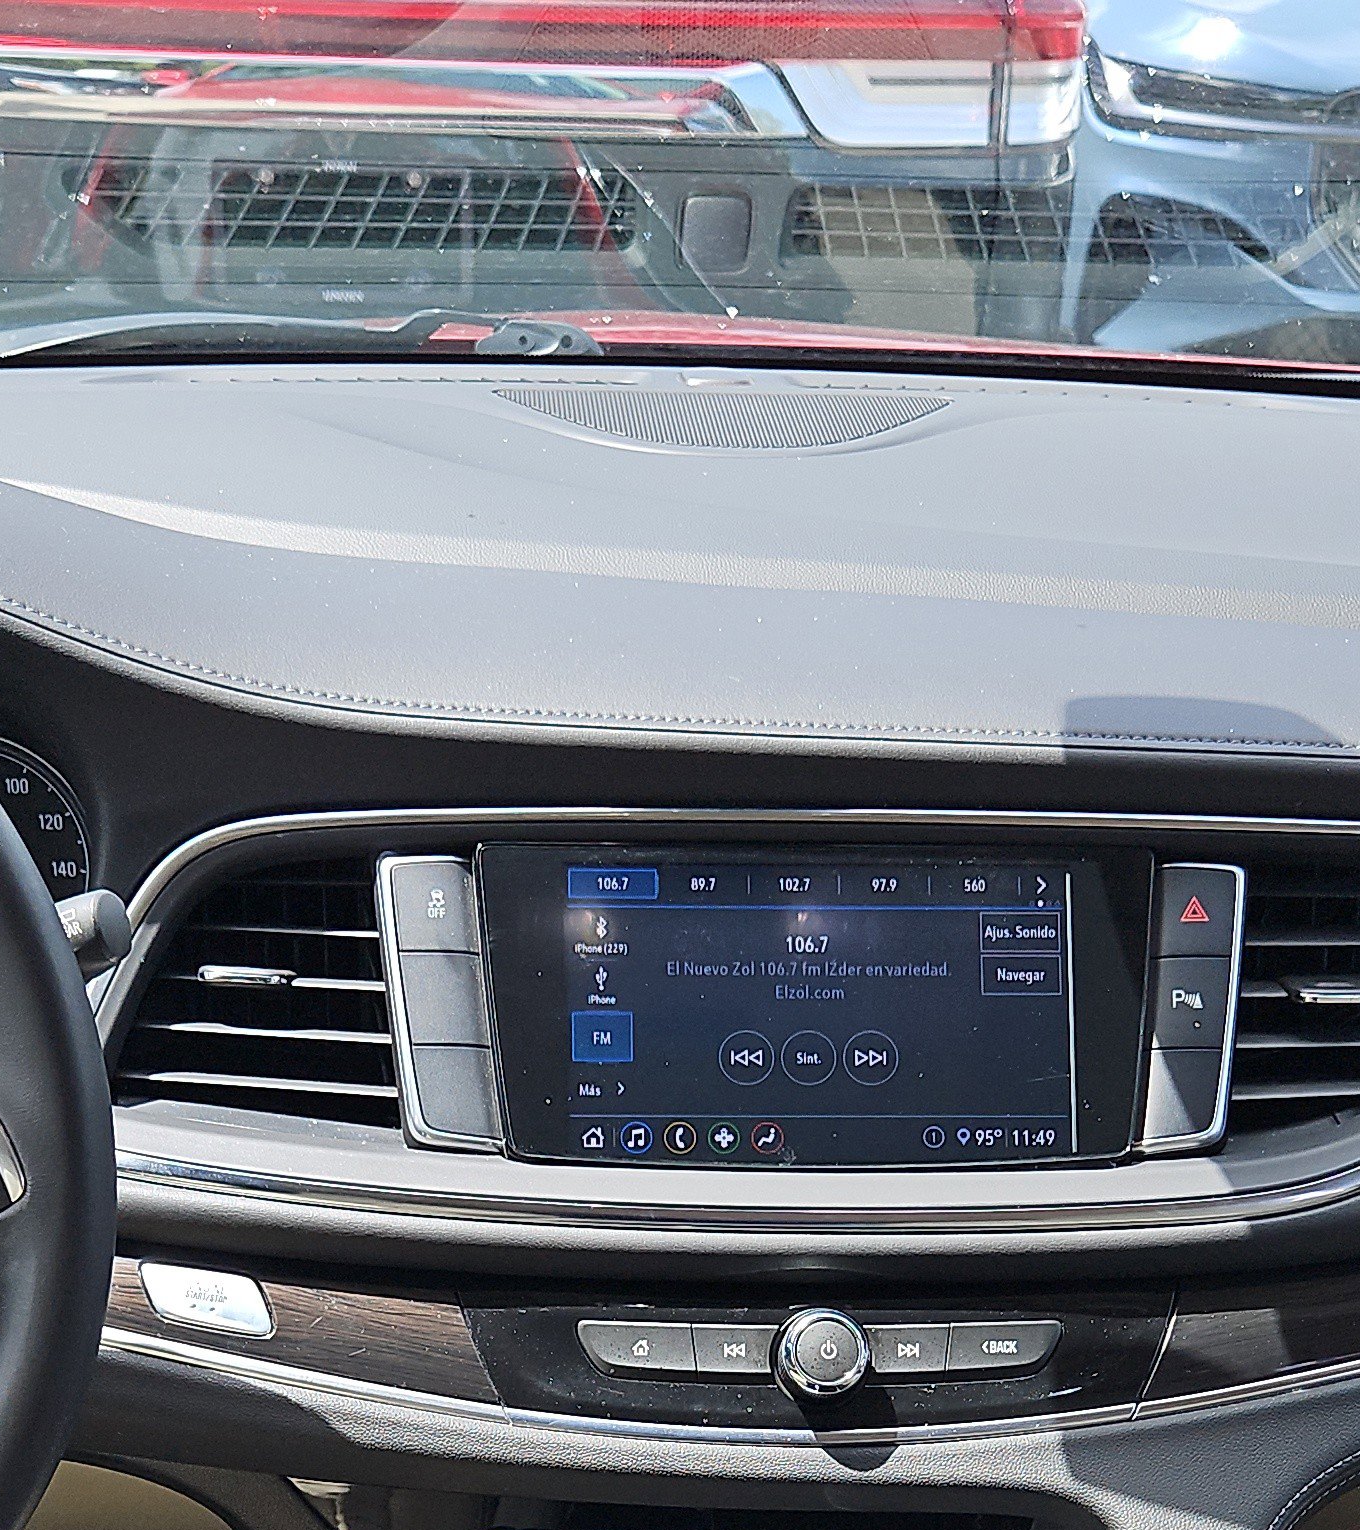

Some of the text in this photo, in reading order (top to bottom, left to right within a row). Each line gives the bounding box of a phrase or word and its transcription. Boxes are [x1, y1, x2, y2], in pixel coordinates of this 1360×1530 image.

[5, 778, 29, 795] 100
[39, 814, 63, 831] 120
[51, 861, 77, 877] 140
[597, 877, 629, 891] 106.7
[690, 877, 716, 891] 89.7
[779, 877, 811, 892] 102.7
[871, 877, 897, 893] 97.9
[963, 877, 986, 892] 560
[427, 907, 446, 919] OFF
[984, 925, 1056, 942] Ajus. Sonido
[574, 943, 628, 956] iPhone (229)
[785, 935, 829, 953] 106.7
[666, 961, 680, 976] El
[684, 962, 729, 976] Nuevo
[732, 961, 755, 976] Zol
[760, 962, 797, 976] 106.7
[802, 961, 821, 976] fm
[865, 965, 883, 976] en
[886, 961, 952, 976] variedad.
[996, 967, 1045, 985] Navegar
[587, 994, 616, 1005] iPhone
[775, 984, 845, 1000] Elzol.com
[593, 1031, 612, 1045] FM
[796, 1051, 822, 1065] Sint.
[579, 1083, 601, 1096] Más
[1012, 1129, 1055, 1146] 11:49
